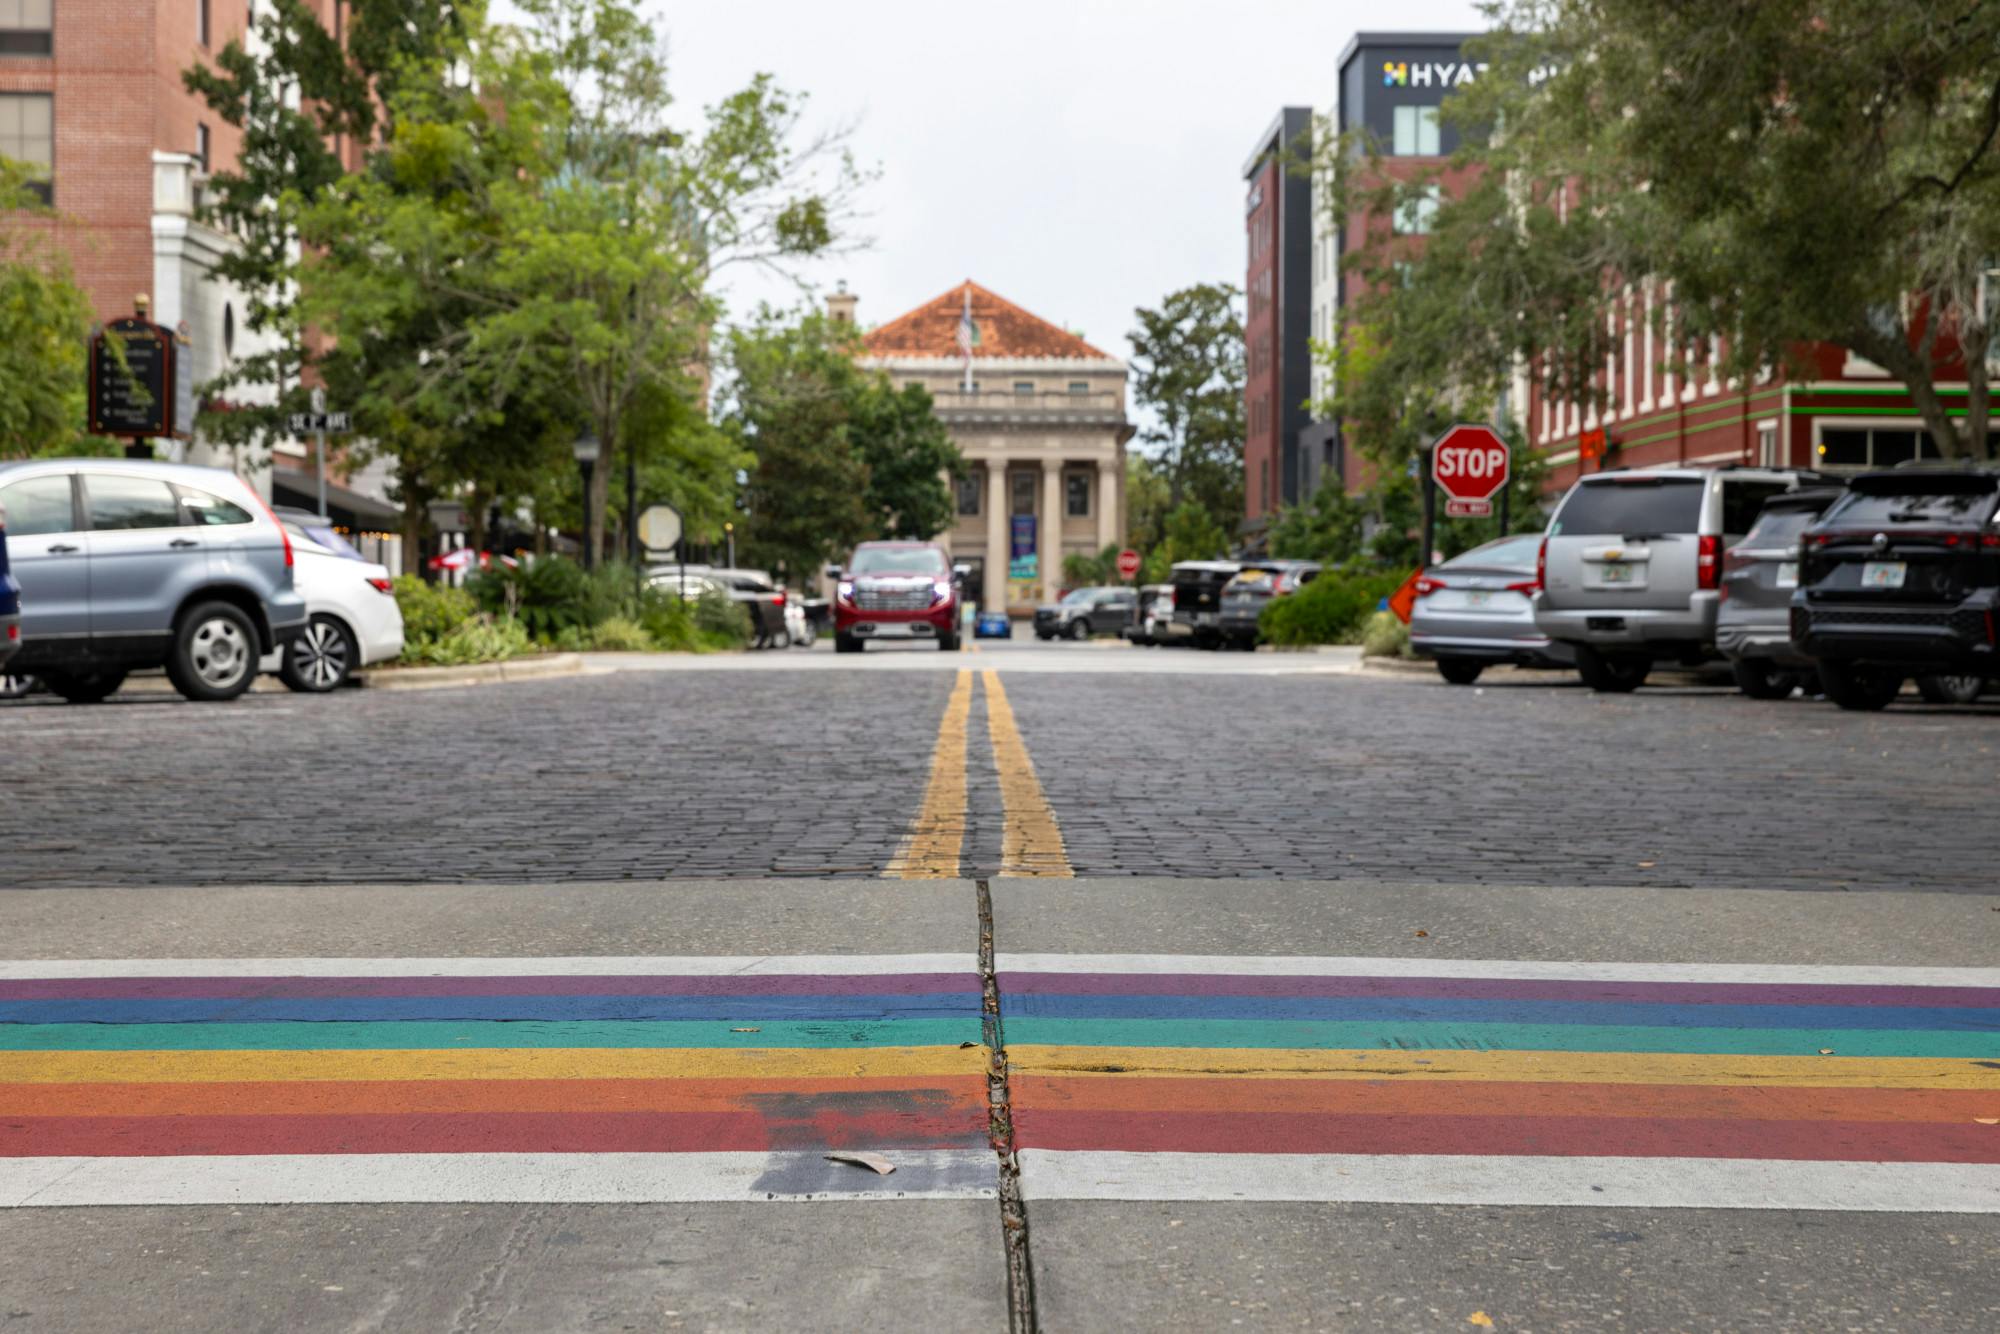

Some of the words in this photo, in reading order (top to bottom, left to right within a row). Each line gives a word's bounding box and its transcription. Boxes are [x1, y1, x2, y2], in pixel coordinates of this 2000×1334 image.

[1411, 62, 1489, 87] HYA
[1438, 446, 1505, 478] STOP
[1118, 556, 1140, 567] STOP
